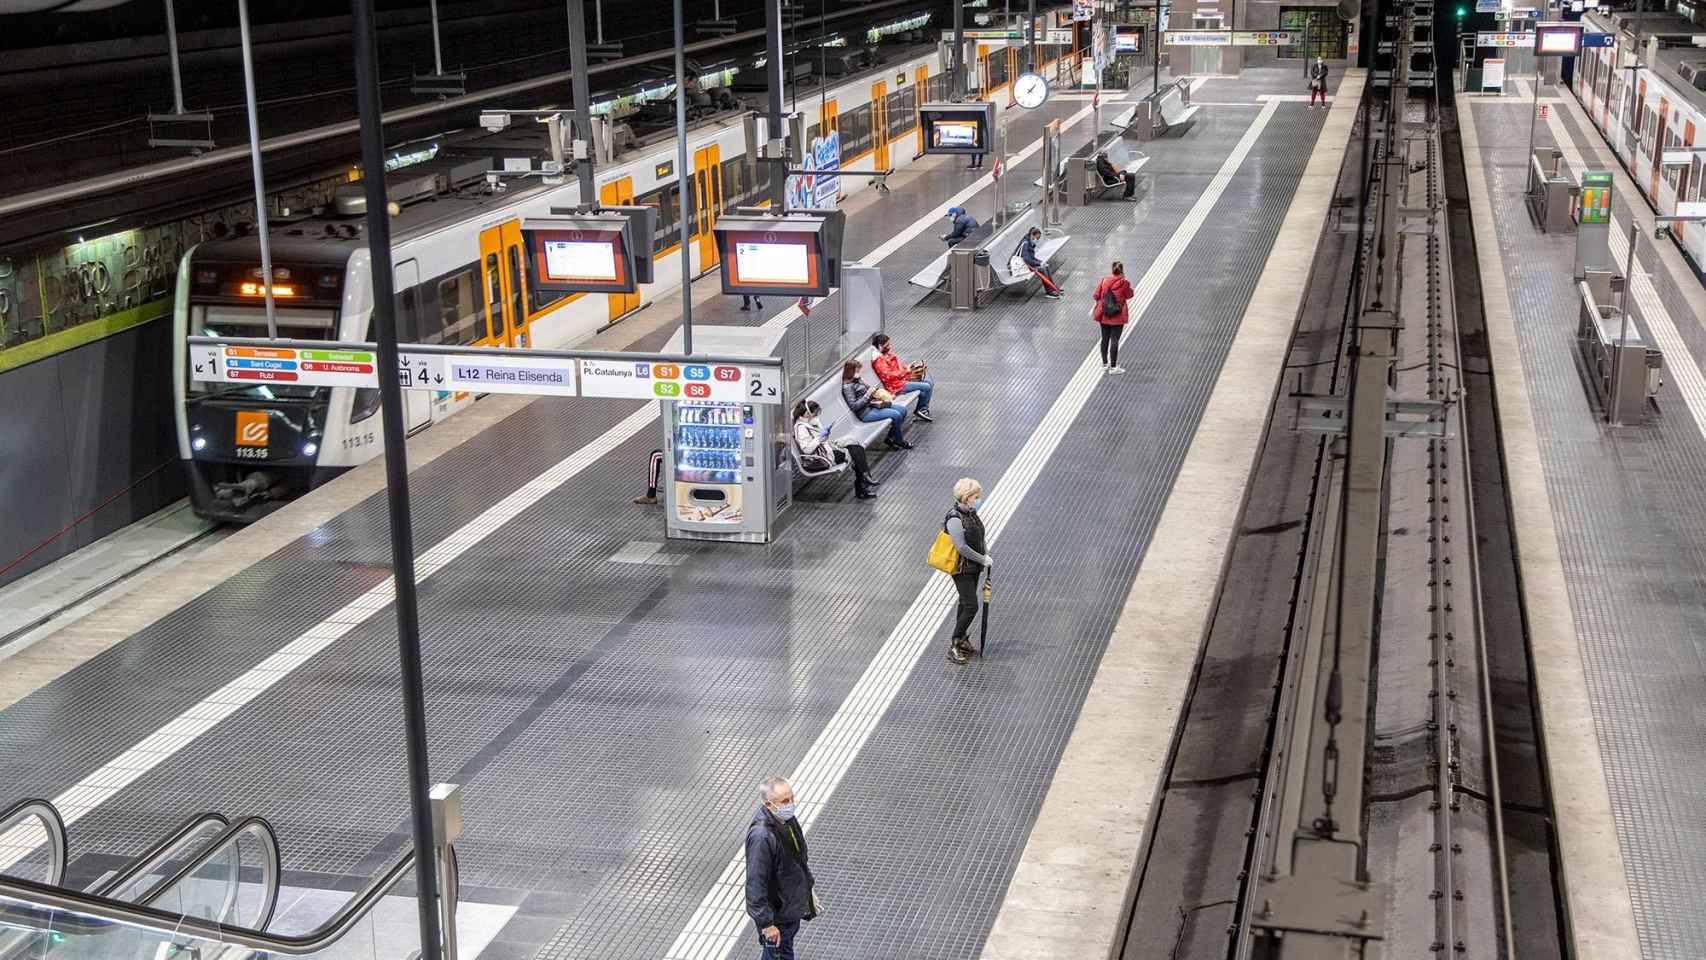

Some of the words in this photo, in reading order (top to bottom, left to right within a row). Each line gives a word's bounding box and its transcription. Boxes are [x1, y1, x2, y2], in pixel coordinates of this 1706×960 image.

[209, 358, 217, 374] 1
[250, 360, 264, 368] Sant
[418, 368, 430, 384] 4
[458, 368, 479, 380] L12
[486, 369, 515, 381] Reina
[518, 371, 563, 383] Elisenda
[594, 368, 632, 377] Catalunya
[636, 367, 648, 376] L6
[660, 367, 673, 376] S1
[690, 368, 704, 378] S5
[720, 369, 734, 379] S7
[660, 384, 673, 393] S2
[750, 380, 762, 396] 2
